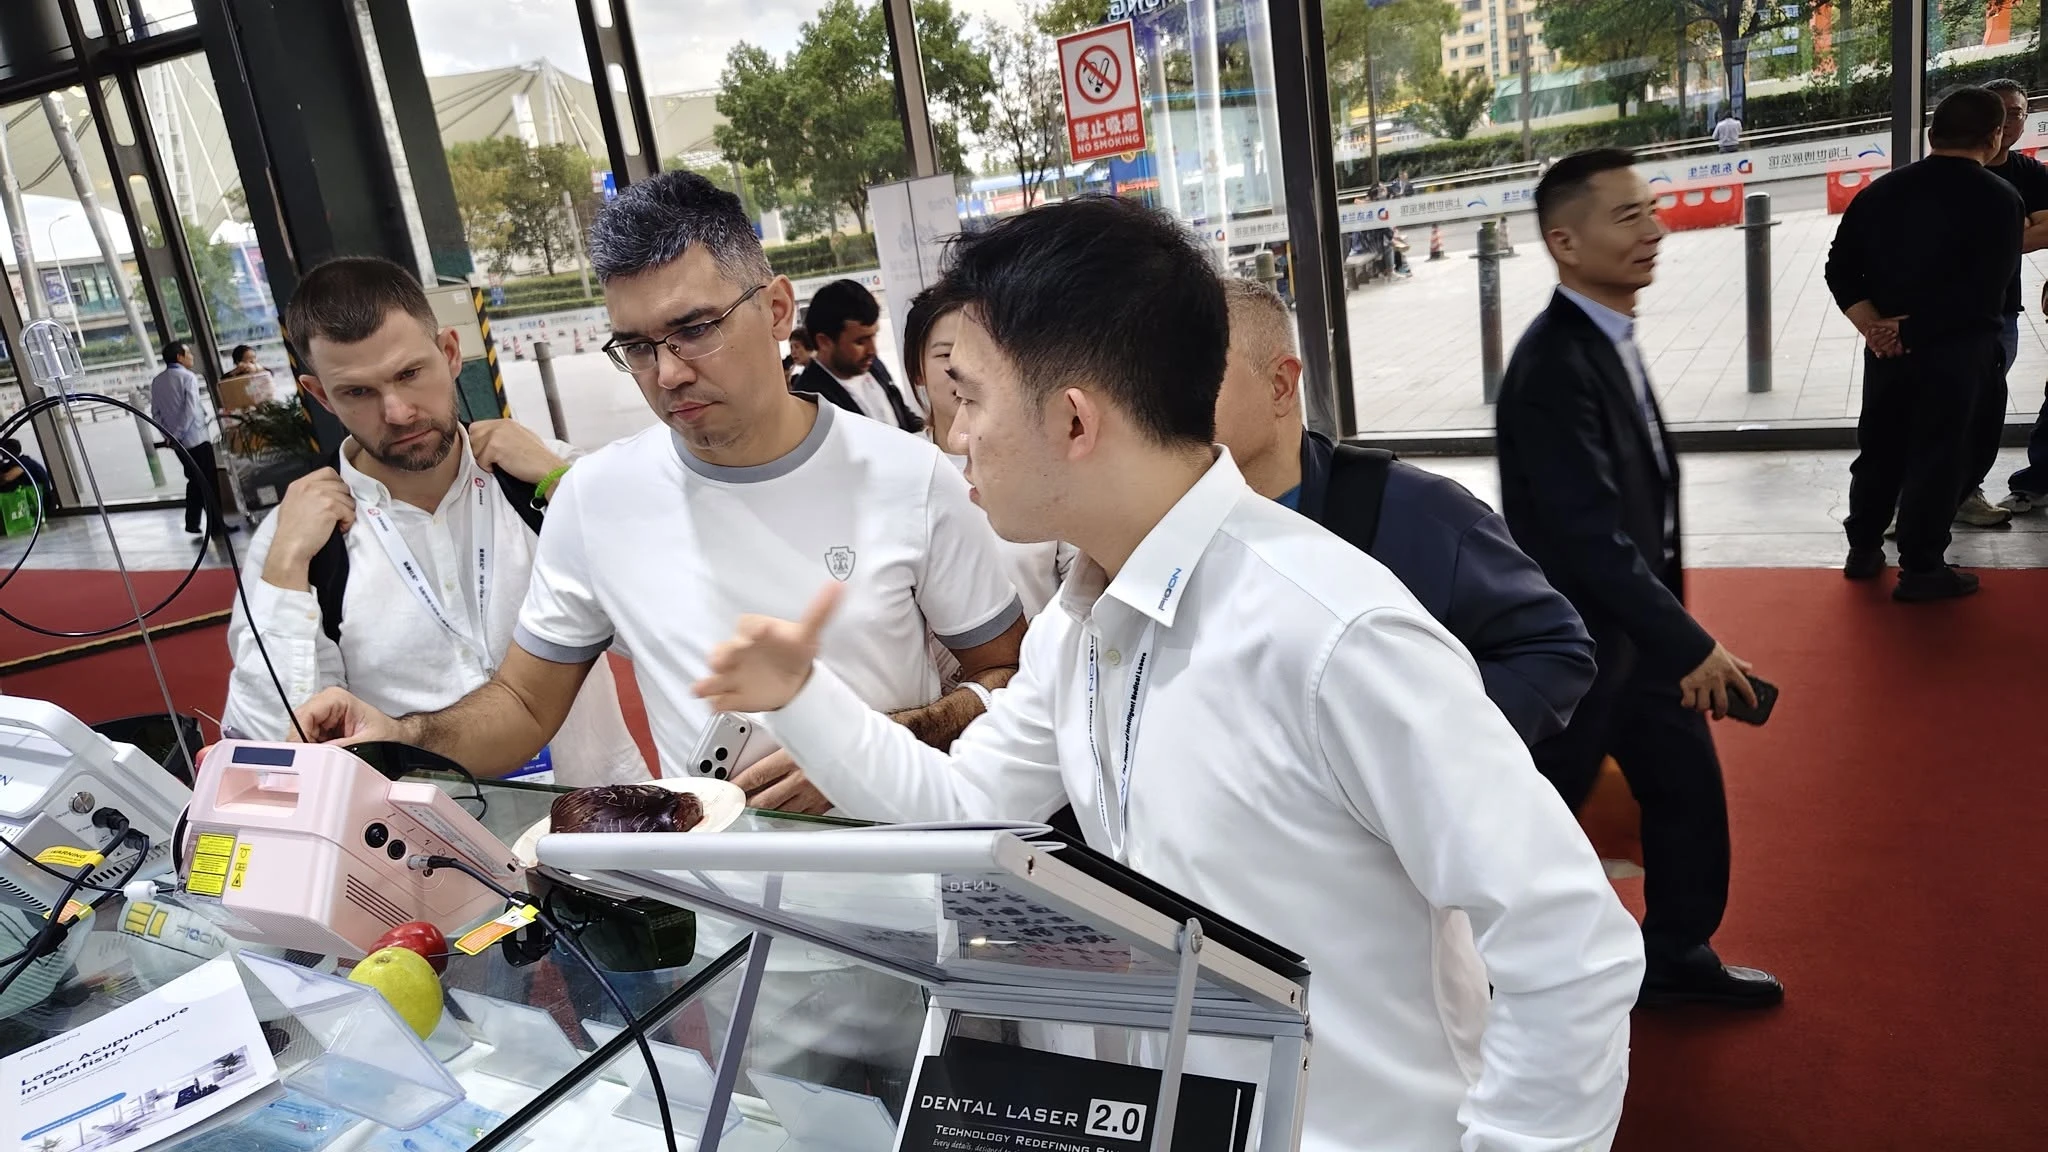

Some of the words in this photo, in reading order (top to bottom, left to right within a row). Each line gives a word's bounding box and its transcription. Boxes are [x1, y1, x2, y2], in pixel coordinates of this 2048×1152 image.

[1074, 112, 1138, 142] 禁止吸烟
[1077, 143, 1092, 154] NO
[1093, 133, 1140, 151] SMOKING
[1131, 675, 1141, 701] Medical
[1136, 652, 1147, 675] Lasers
[21, 1060, 74, 1086] Laser
[79, 1006, 190, 1061] Acupuncture
[21, 1085, 38, 1096] in
[43, 1044, 130, 1086] Dentistry
[920, 1095, 997, 1117] DENTAL
[1006, 1104, 1079, 1128] LASER
[1092, 1104, 1140, 1135] 2.0
[932, 1138, 950, 1149] Every
[935, 1124, 1011, 1143] TECHNOLOGY
